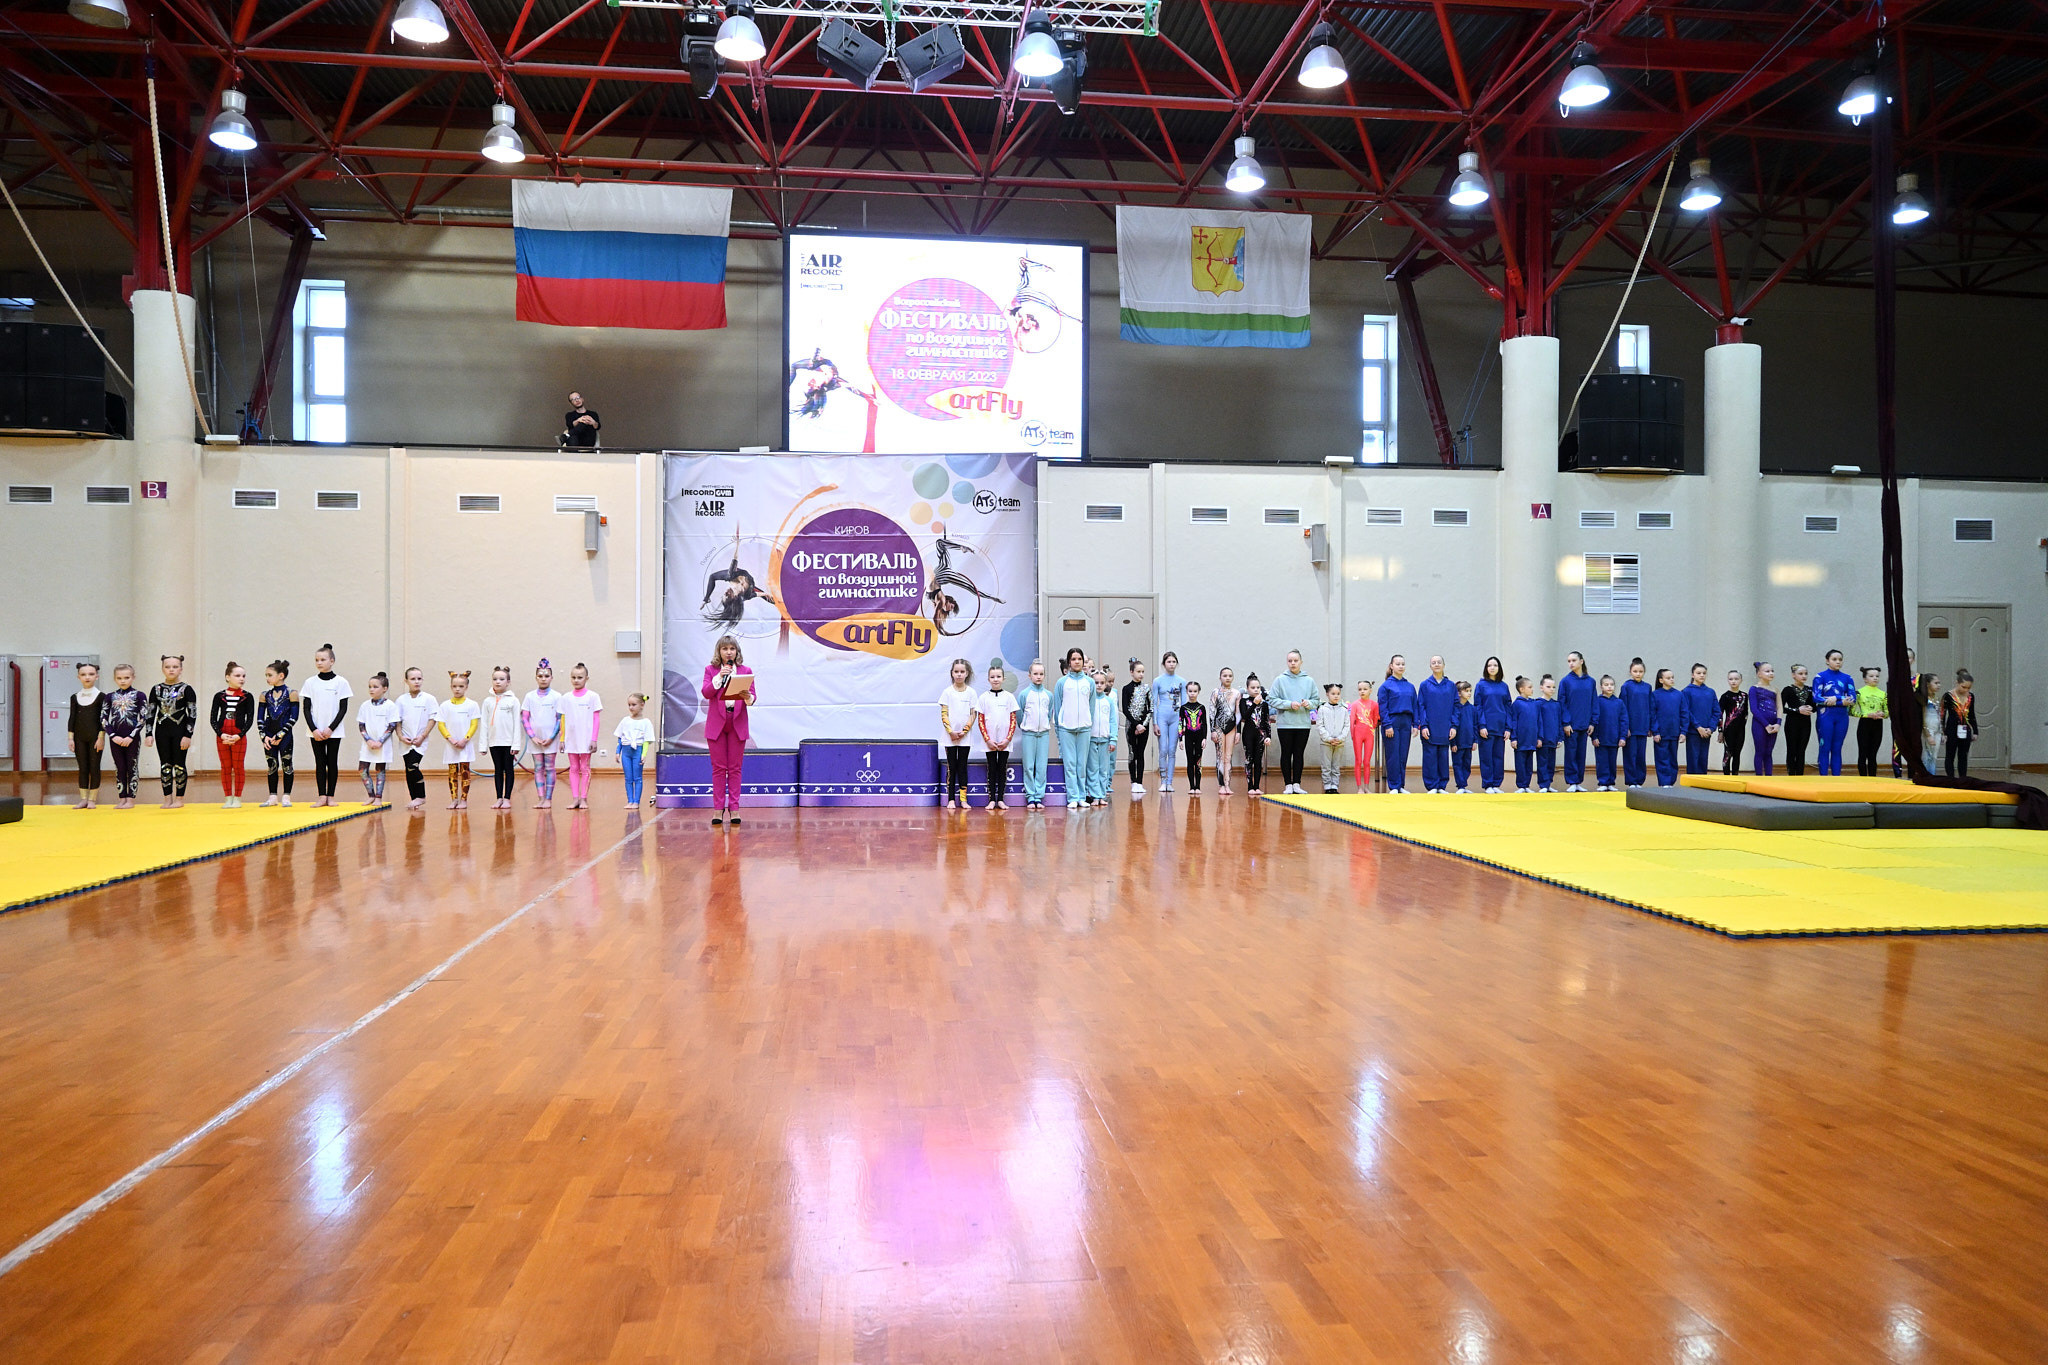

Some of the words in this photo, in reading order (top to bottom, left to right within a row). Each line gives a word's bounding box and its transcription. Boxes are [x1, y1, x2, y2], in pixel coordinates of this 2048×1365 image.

[806, 254, 843, 268] AIR
[879, 307, 1009, 332] ФЕСТИВАЛЬ
[905, 333, 925, 344] по
[905, 346, 1009, 360] гимнастике
[890, 367, 905, 380] 18
[907, 368, 966, 381] ФЕВРАЛЯ
[968, 370, 998, 383] 2023
[949, 390, 1024, 420] artFly
[1049, 429, 1075, 440] team
[147, 482, 160, 498] B
[699, 500, 725, 511] AIR
[998, 496, 1021, 507] team
[1537, 503, 1548, 519] A
[834, 525, 870, 536] КИРОВ
[791, 550, 918, 573] ФЕСТИВАЛЬ
[818, 574, 836, 585] по
[838, 572, 918, 587] воздушной
[818, 584, 918, 599] гимнастике
[843, 619, 932, 654] artFly
[862, 751, 871, 768] 1
[1006, 767, 1016, 782] 3
